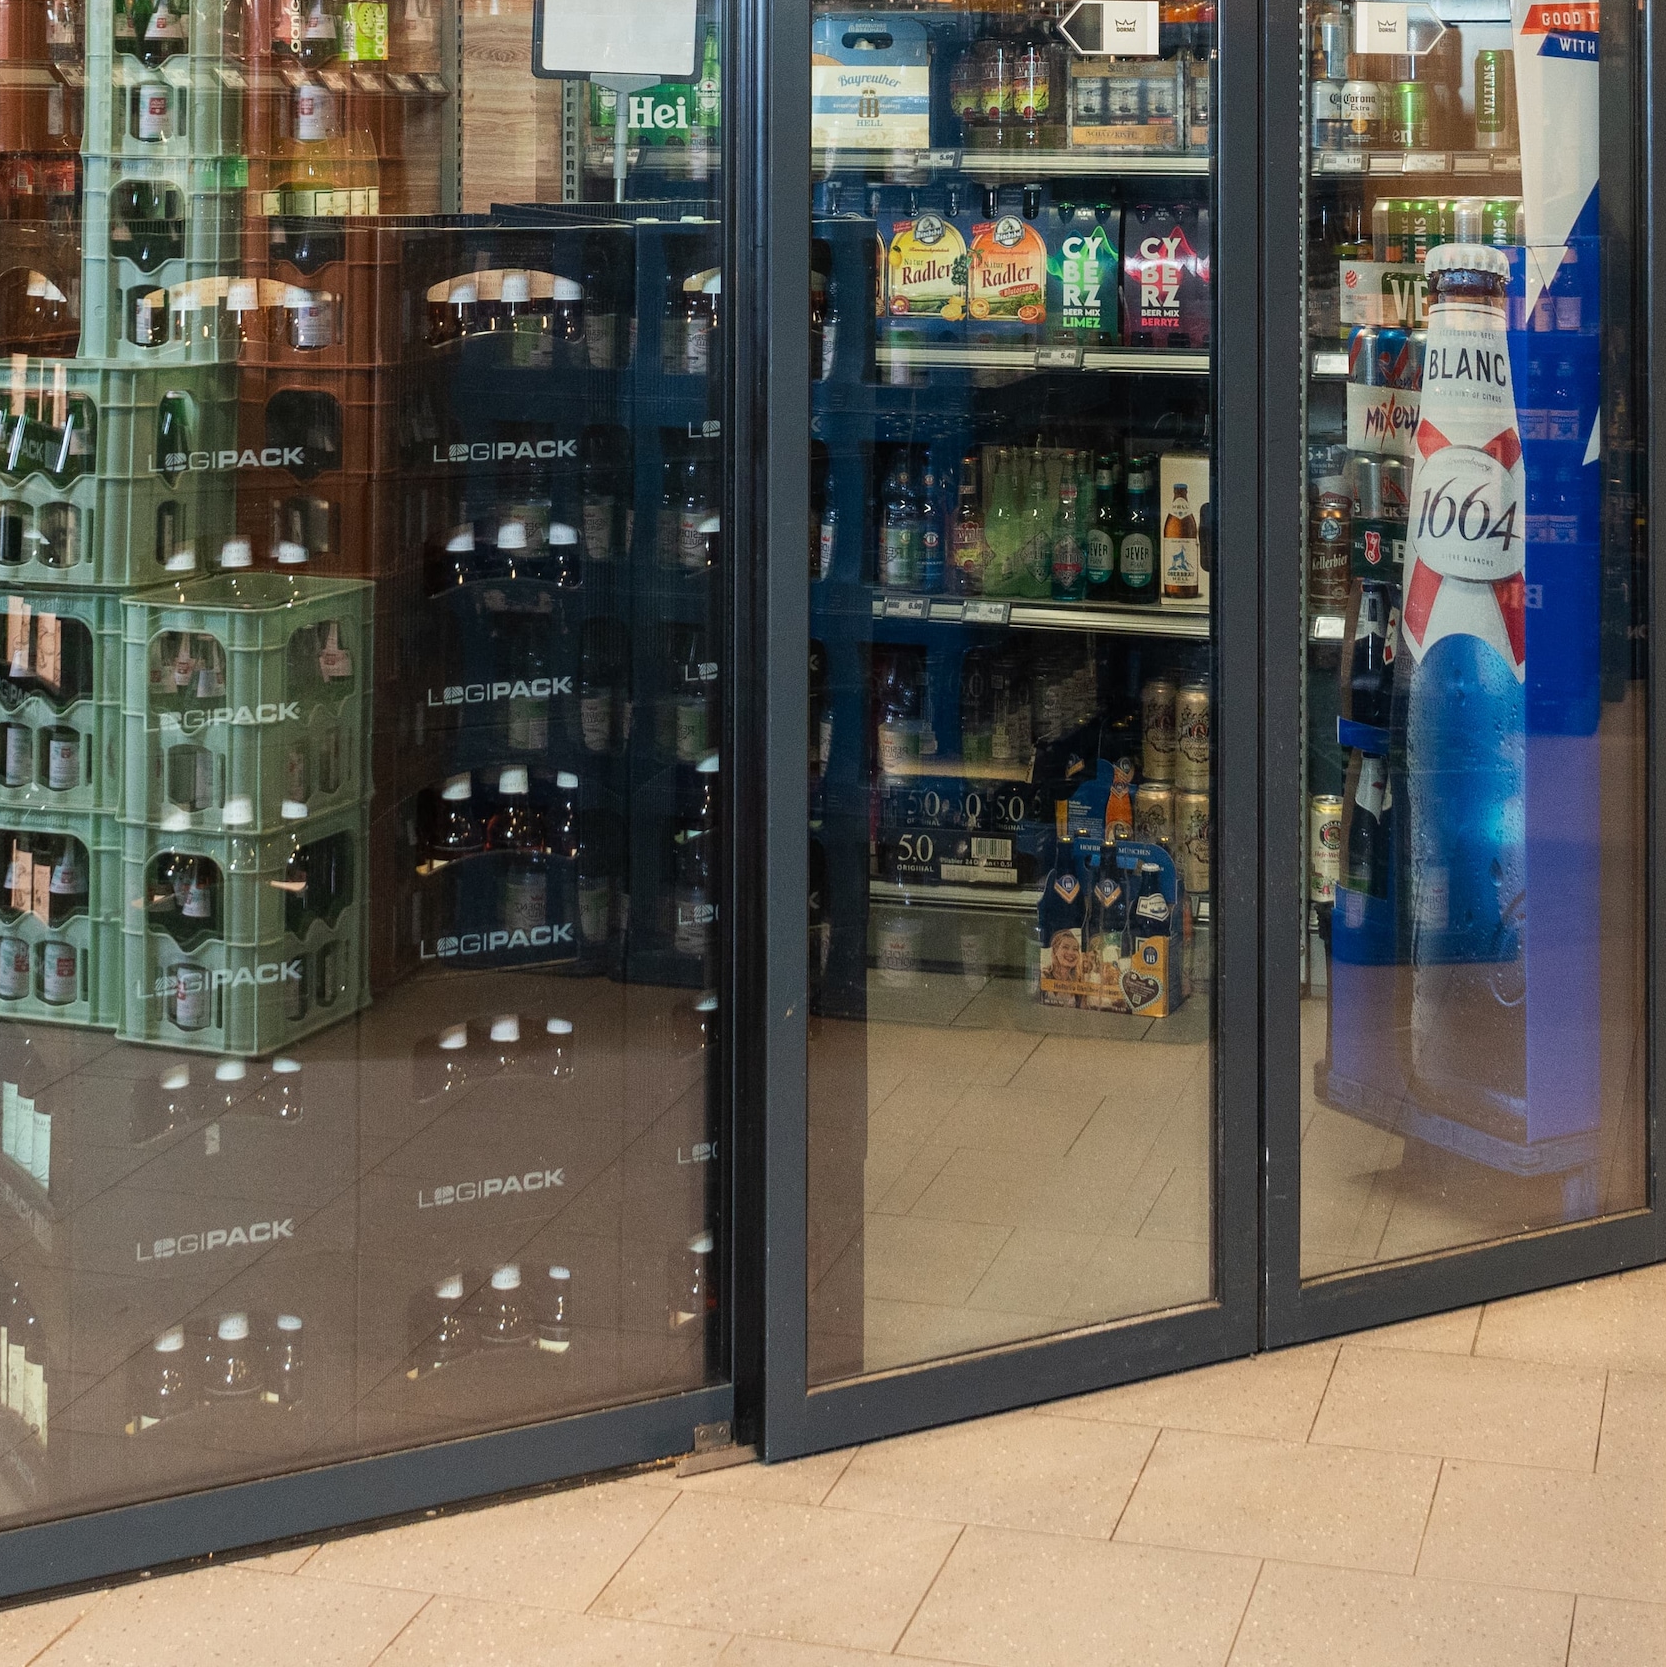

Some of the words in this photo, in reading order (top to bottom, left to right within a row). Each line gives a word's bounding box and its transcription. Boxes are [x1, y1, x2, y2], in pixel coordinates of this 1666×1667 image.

[1541, 12, 1582, 27] GOOD
[1559, 37, 1596, 54] WITH
[837, 73, 902, 90] Bayreuther
[1483, 62, 1496, 116] VELTINS
[1343, 93, 1376, 105] Corona
[856, 119, 883, 127] HELL
[1062, 235, 1101, 259] CY
[1141, 235, 1180, 259] CY
[901, 260, 954, 286] Radler
[982, 263, 1034, 288] Radler
[1063, 261, 1100, 283] BE
[1142, 261, 1179, 283] BE
[1063, 285, 1101, 306] RZ
[1142, 285, 1180, 306] RZ
[1063, 308, 1081, 316] BEER
[1142, 308, 1160, 316] BEER
[1063, 317, 1100, 328] LIMEZ
[1142, 317, 1179, 327] BERRYZ
[1428, 347, 1507, 387] BLANC
[1416, 477, 1521, 552] 1664
[1125, 546, 1150, 560] JEVER
[896, 834, 934, 863] 5,0
[1117, 845, 1151, 856] MÜNCHEN
[896, 863, 934, 873] ORIGINAL
